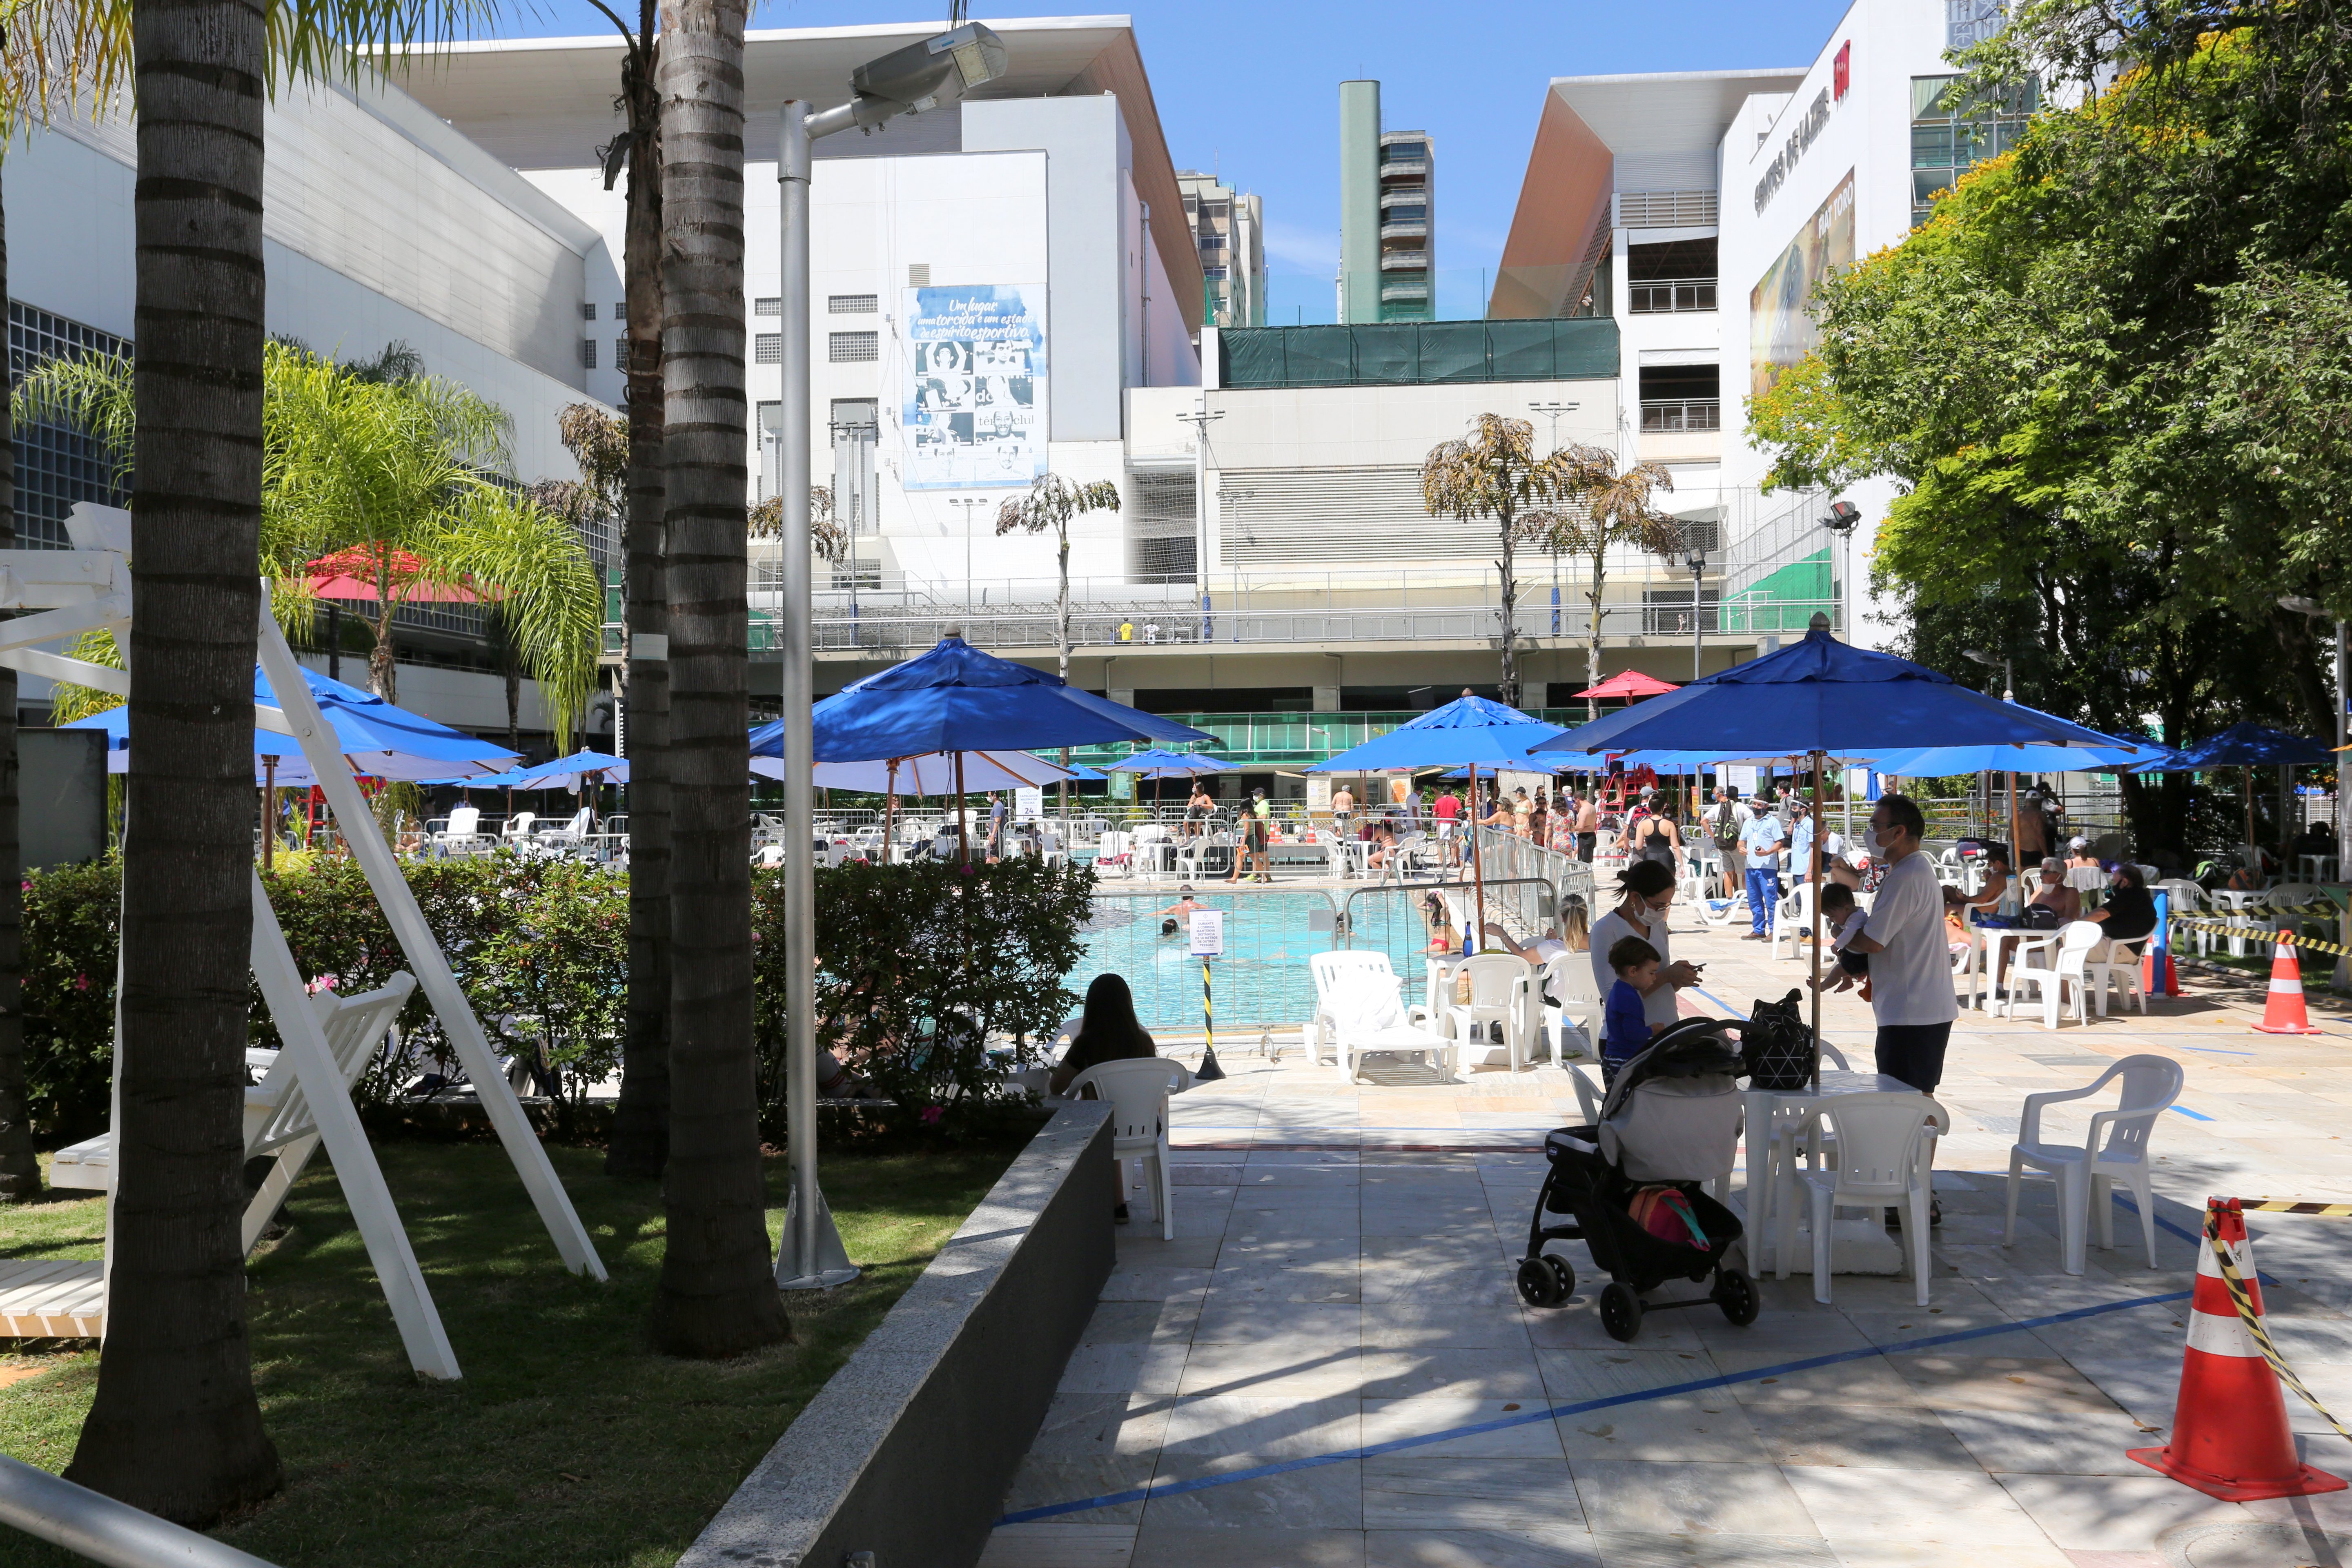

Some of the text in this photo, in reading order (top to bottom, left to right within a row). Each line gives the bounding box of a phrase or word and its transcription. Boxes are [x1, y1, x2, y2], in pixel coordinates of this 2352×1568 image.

[1755, 86, 1830, 212] CENTRO DE LAZER
[1819, 181, 1853, 239] FIAT TORO
[949, 296, 998, 317] Um lugar,
[936, 310, 975, 326] torcida
[1001, 310, 1034, 325] estado
[920, 324, 1029, 342] de espírito esportivo.
